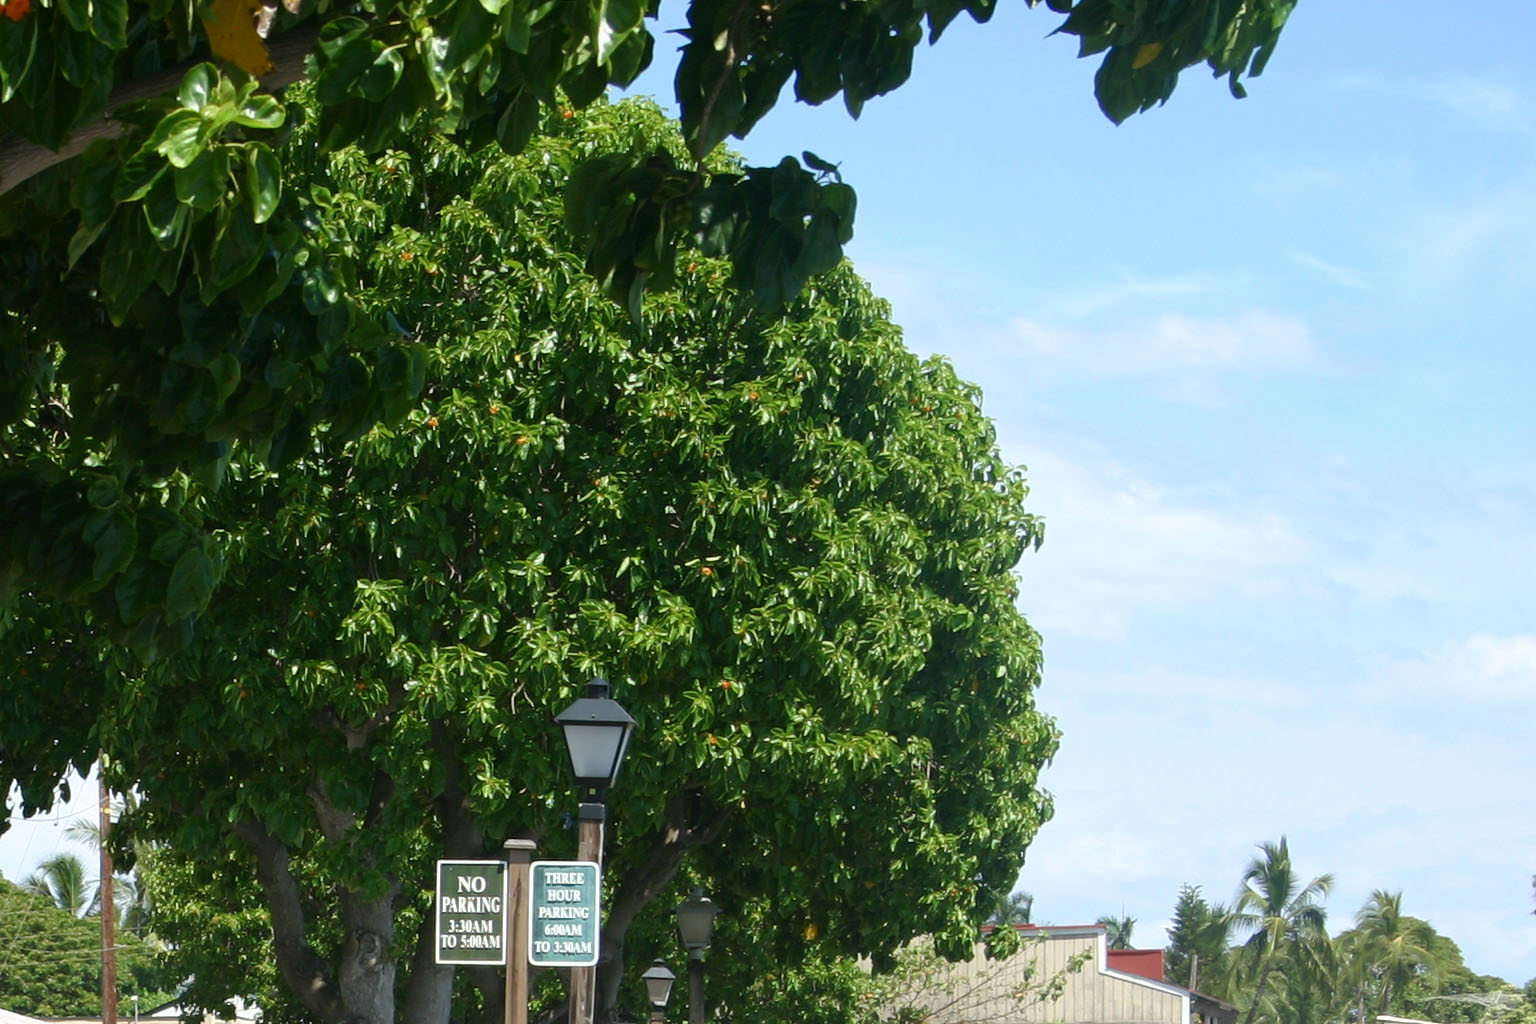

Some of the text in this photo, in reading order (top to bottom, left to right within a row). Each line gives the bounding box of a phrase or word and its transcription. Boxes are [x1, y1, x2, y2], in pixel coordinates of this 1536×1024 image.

[457, 876, 487, 893] NO
[544, 872, 585, 885] THREE
[547, 889, 582, 902] HOUR
[442, 896, 501, 913] PARKING
[538, 906, 590, 919] PARKING
[448, 919, 493, 933] 3:30AM
[544, 924, 583, 937] 6:00AM
[441, 935, 501, 949] TO 5:00AM
[534, 941, 593, 954] TO 3:30AM
